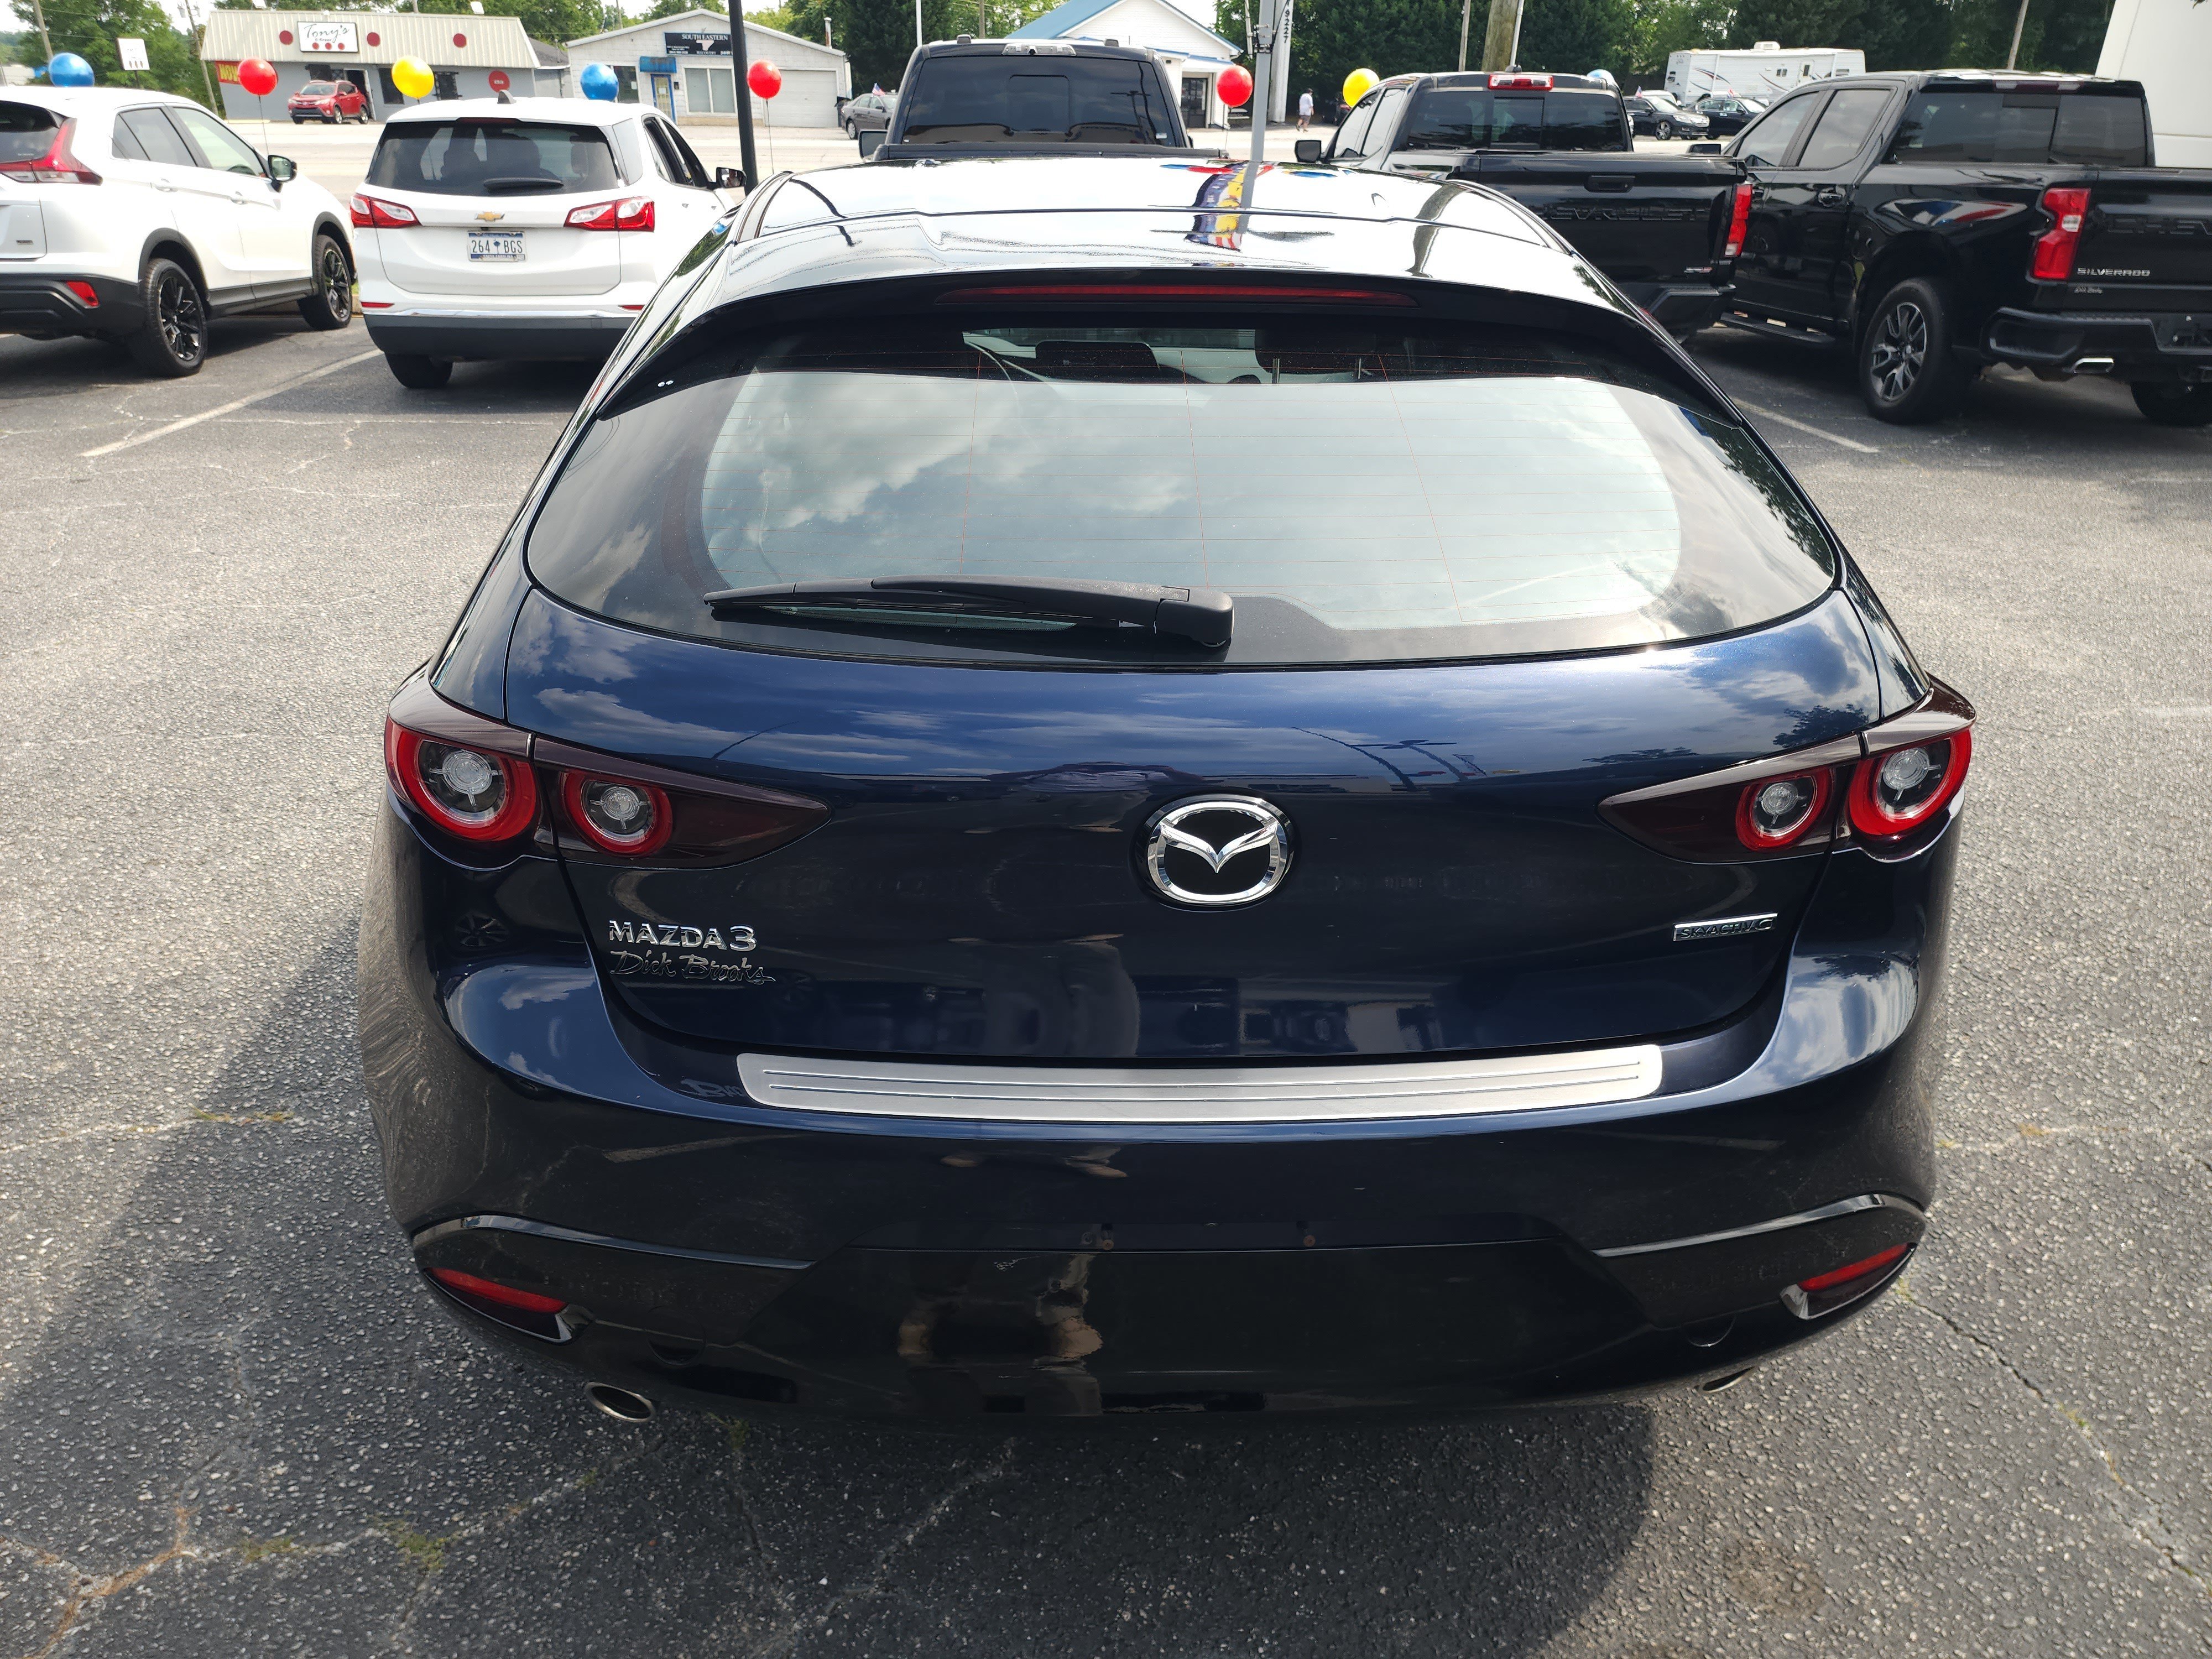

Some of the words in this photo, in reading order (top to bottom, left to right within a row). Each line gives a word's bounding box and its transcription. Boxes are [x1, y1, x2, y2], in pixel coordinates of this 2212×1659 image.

[304, 24, 349, 43] Tony's
[1528, 205, 1712, 221] HEVROLET
[471, 239, 491, 253] 264
[503, 239, 523, 254] BGS
[2077, 268, 2151, 277] SILVERADO
[610, 949, 676, 978] Dick
[679, 953, 776, 985] Brooks
